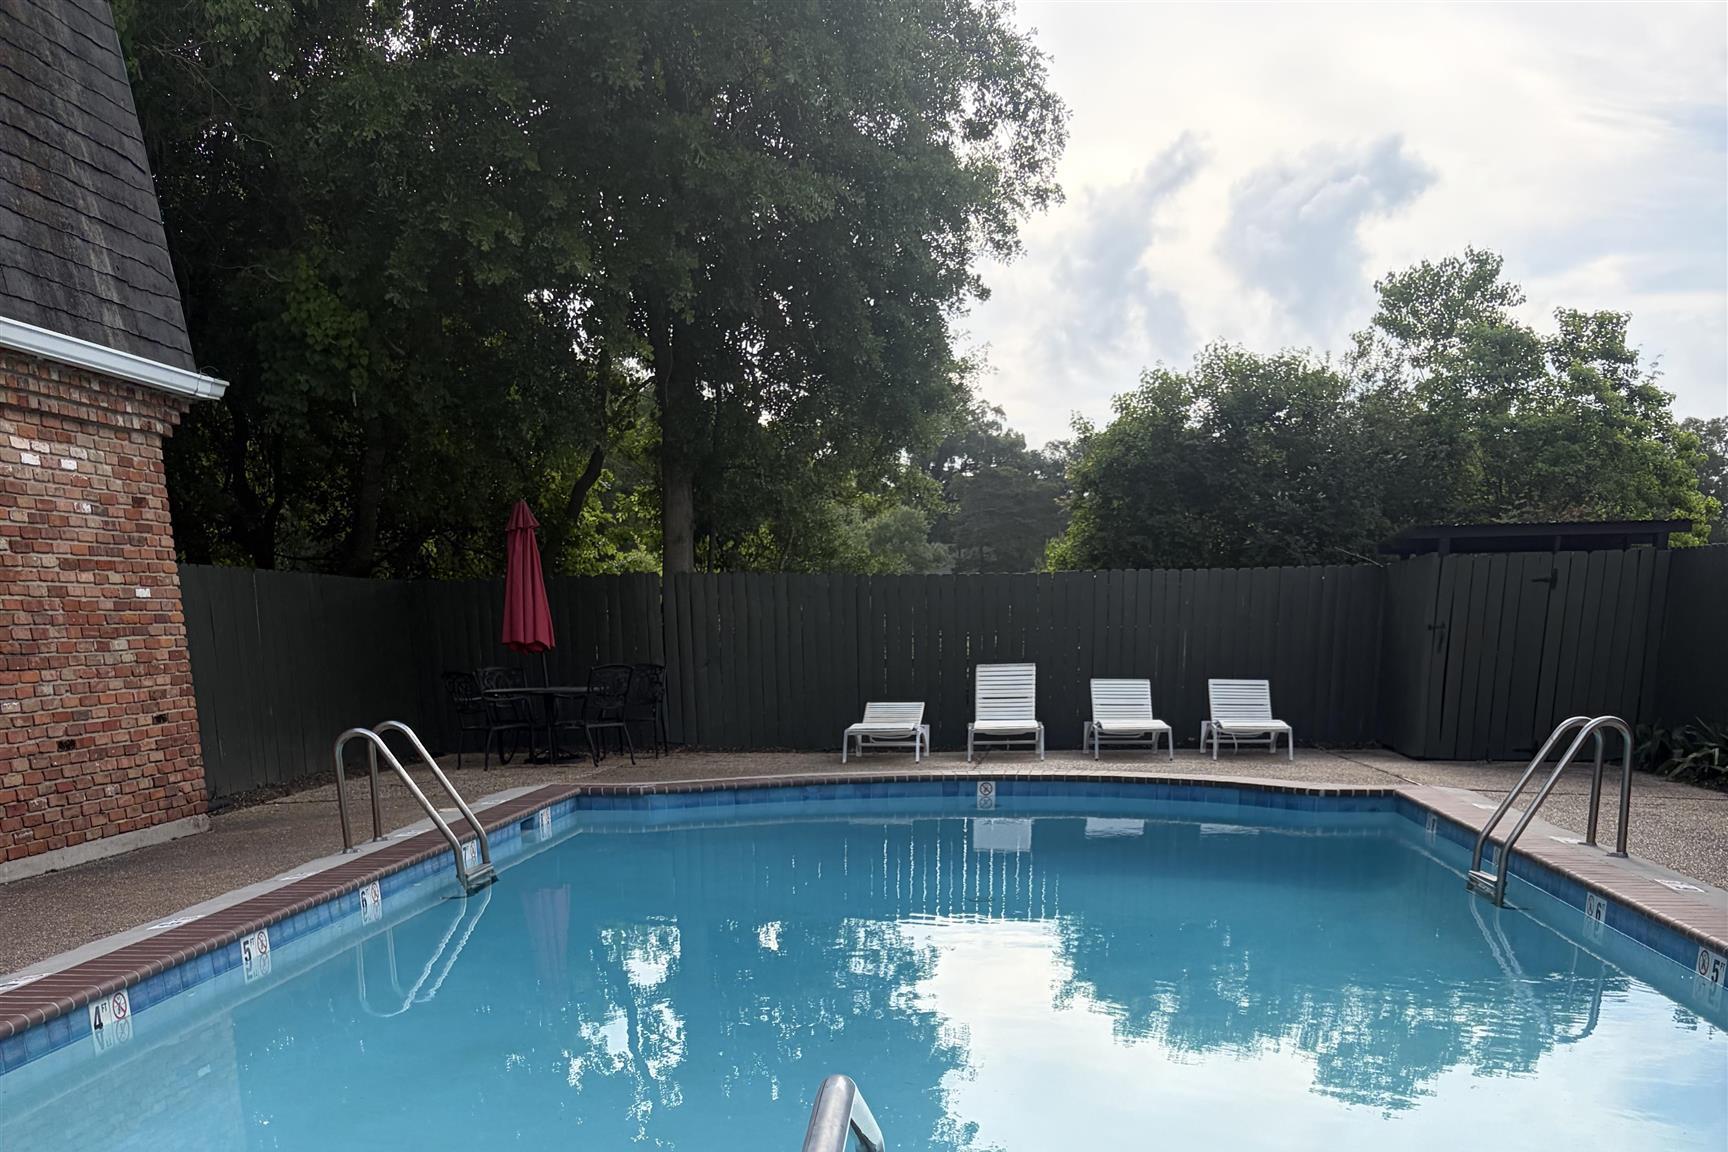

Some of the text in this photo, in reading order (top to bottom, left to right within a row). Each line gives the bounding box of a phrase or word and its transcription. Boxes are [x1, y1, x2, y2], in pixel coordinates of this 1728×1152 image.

[1595, 902, 1601, 921] 6
[243, 940, 251, 961] 5
[1711, 959, 1720, 982] 5
[94, 1005, 103, 1030] 4
